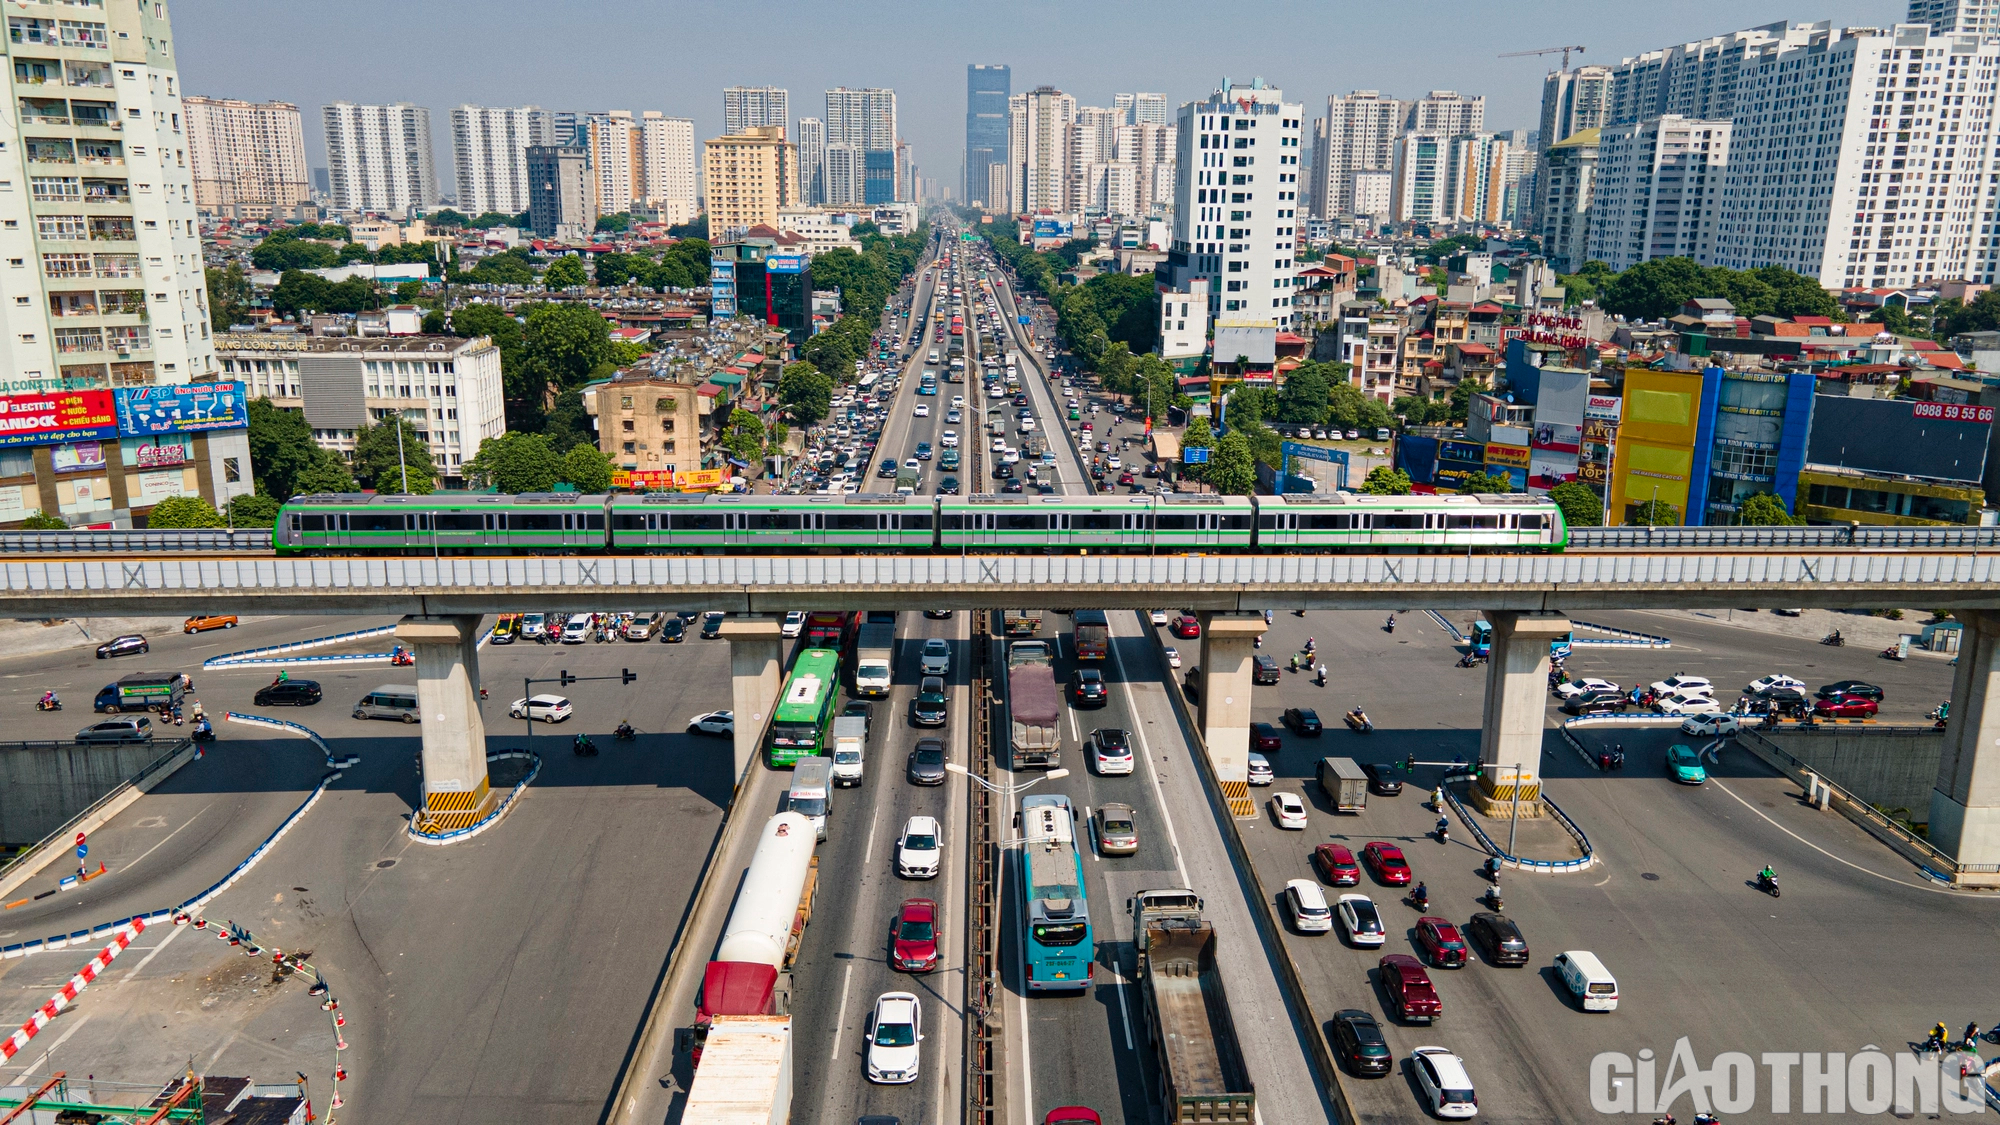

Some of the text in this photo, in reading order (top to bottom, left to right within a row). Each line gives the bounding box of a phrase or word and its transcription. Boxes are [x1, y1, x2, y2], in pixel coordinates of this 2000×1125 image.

[10, 401, 56, 413] ELECTRIC
[1915, 404, 1993, 421] 0988 59 55 66
